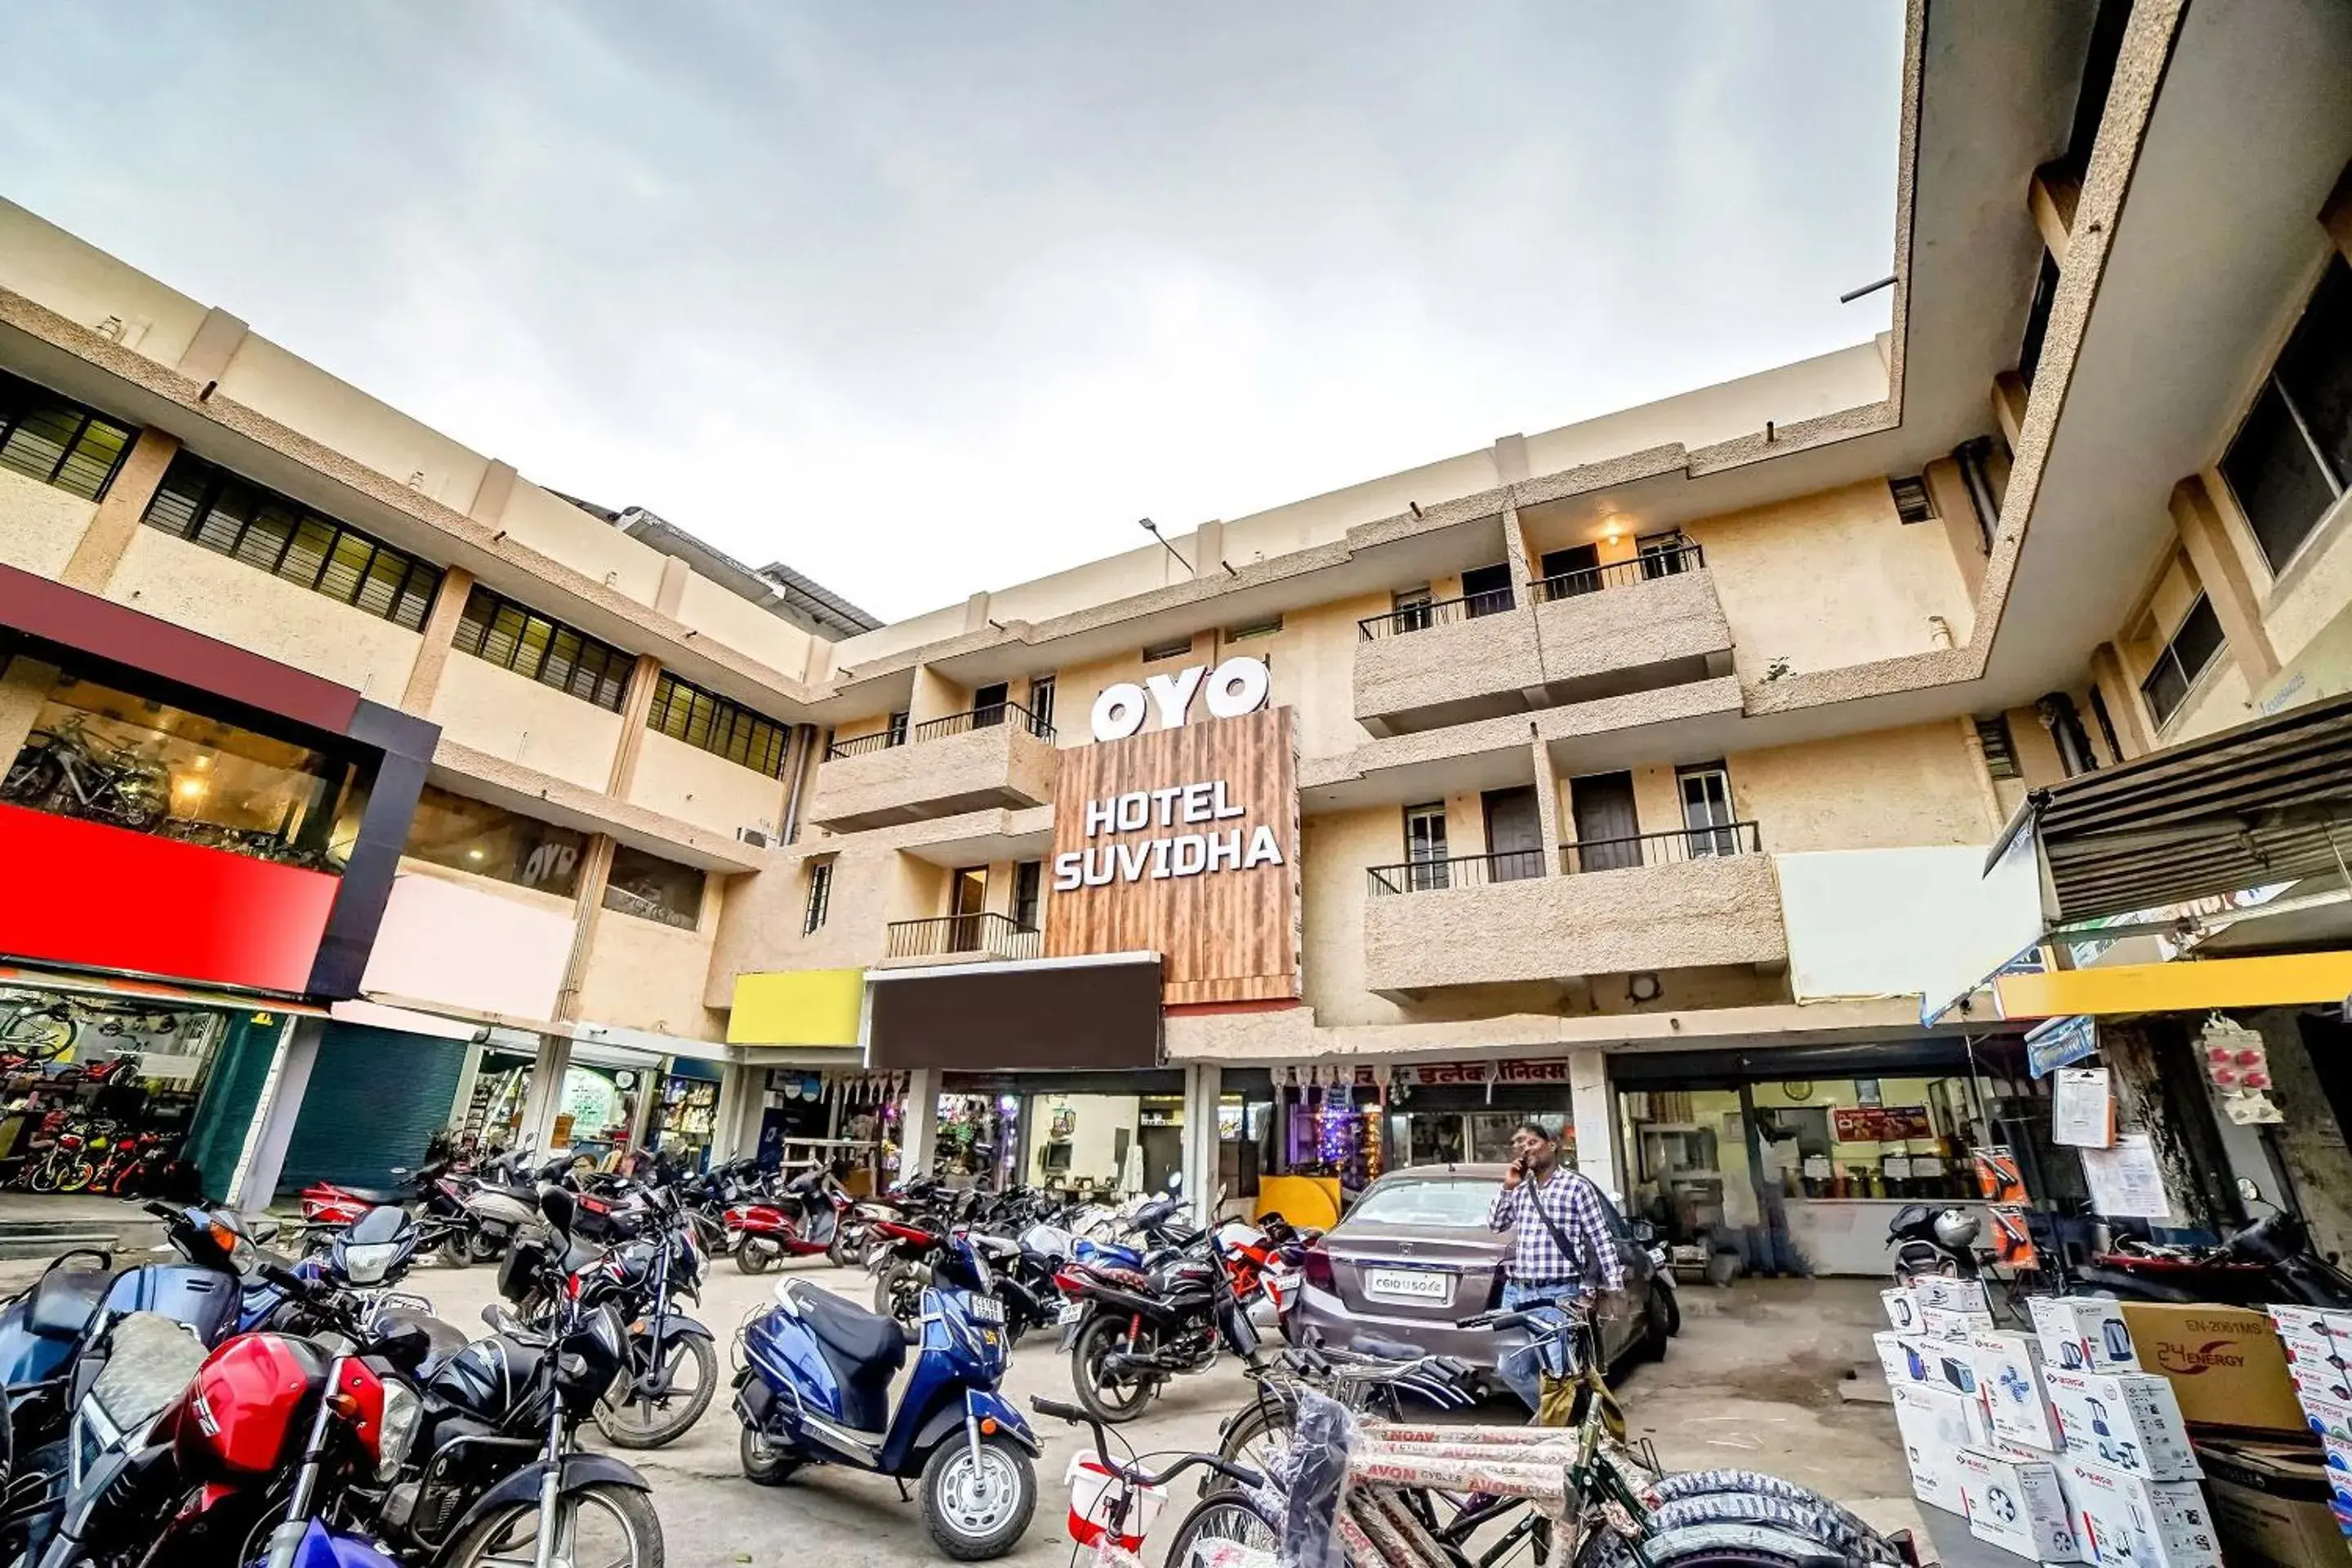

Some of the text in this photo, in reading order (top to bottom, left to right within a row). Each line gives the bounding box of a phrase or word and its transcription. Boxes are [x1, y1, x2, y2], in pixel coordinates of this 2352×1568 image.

[1091, 657, 1270, 742] OYO
[1086, 780, 1246, 838] HOTEL
[1054, 824, 1285, 892] SUVIDHA
[2187, 1352, 2245, 1367] ENERGY
[1366, 1464, 1417, 1481] AVON
